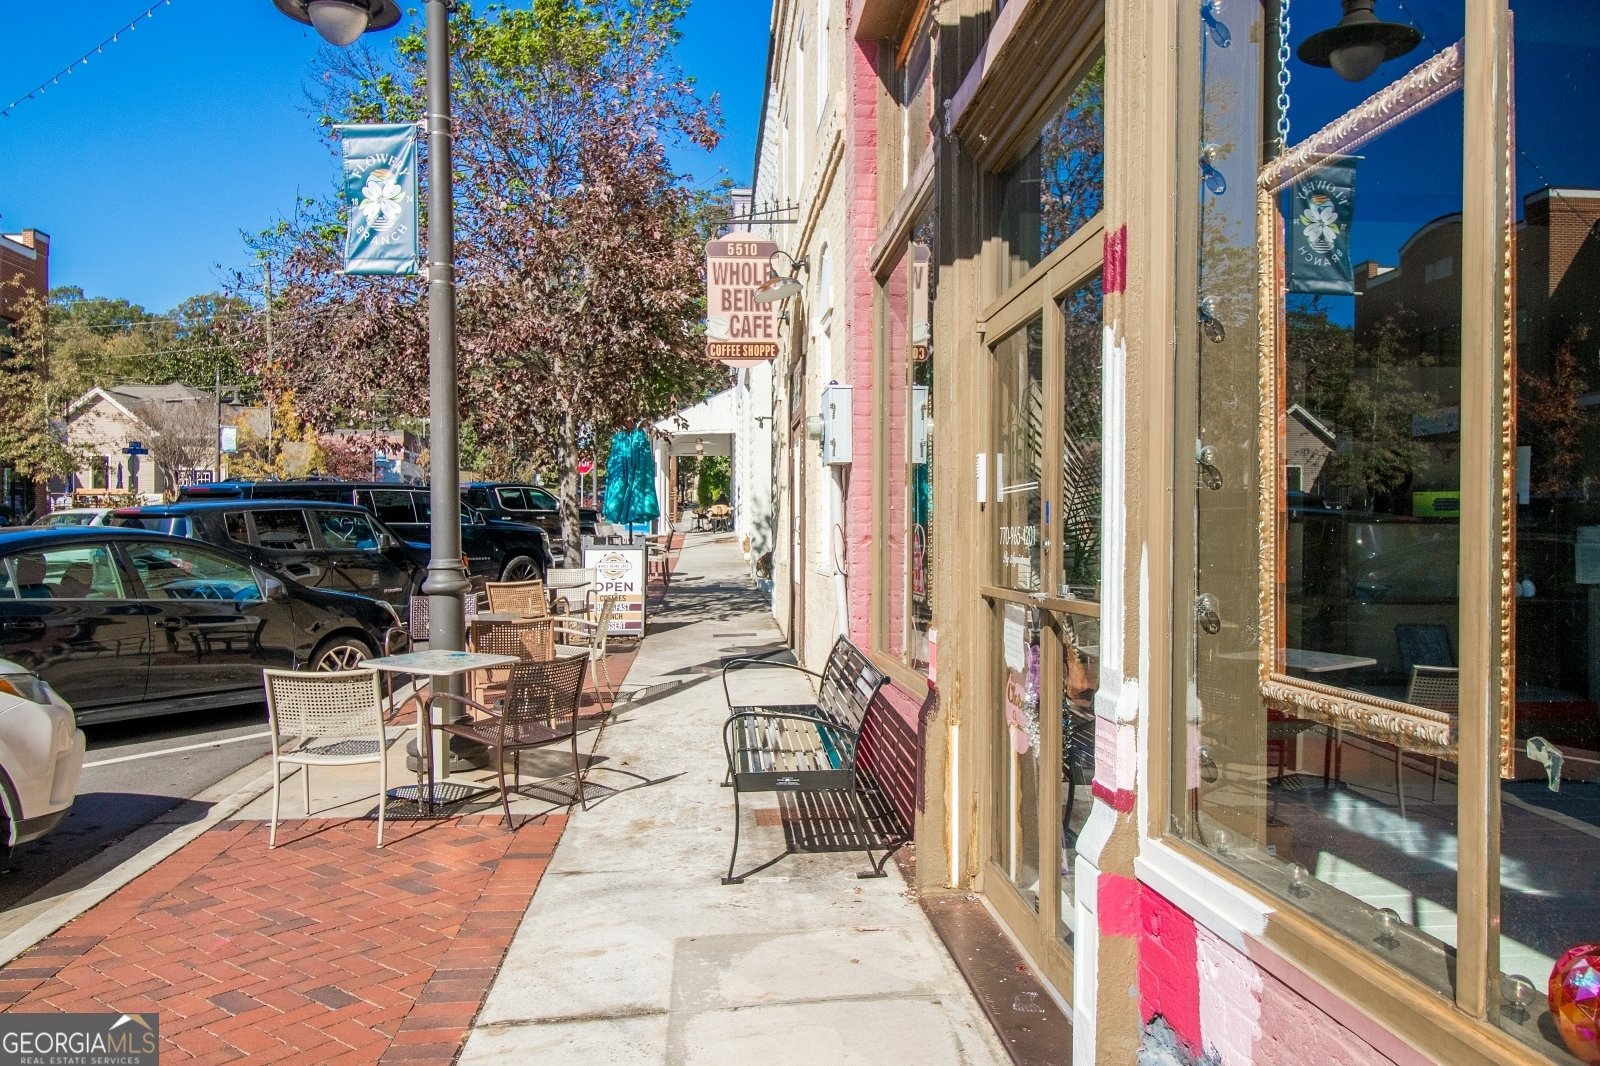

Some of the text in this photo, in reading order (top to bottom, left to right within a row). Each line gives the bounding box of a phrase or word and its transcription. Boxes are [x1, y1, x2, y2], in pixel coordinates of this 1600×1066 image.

[352, 153, 411, 179] FLOWERY
[356, 225, 408, 245] BRANCH
[727, 243, 758, 256] 5510
[729, 314, 773, 338] CAFE
[710, 344, 776, 357] COFFEE SHOPPE
